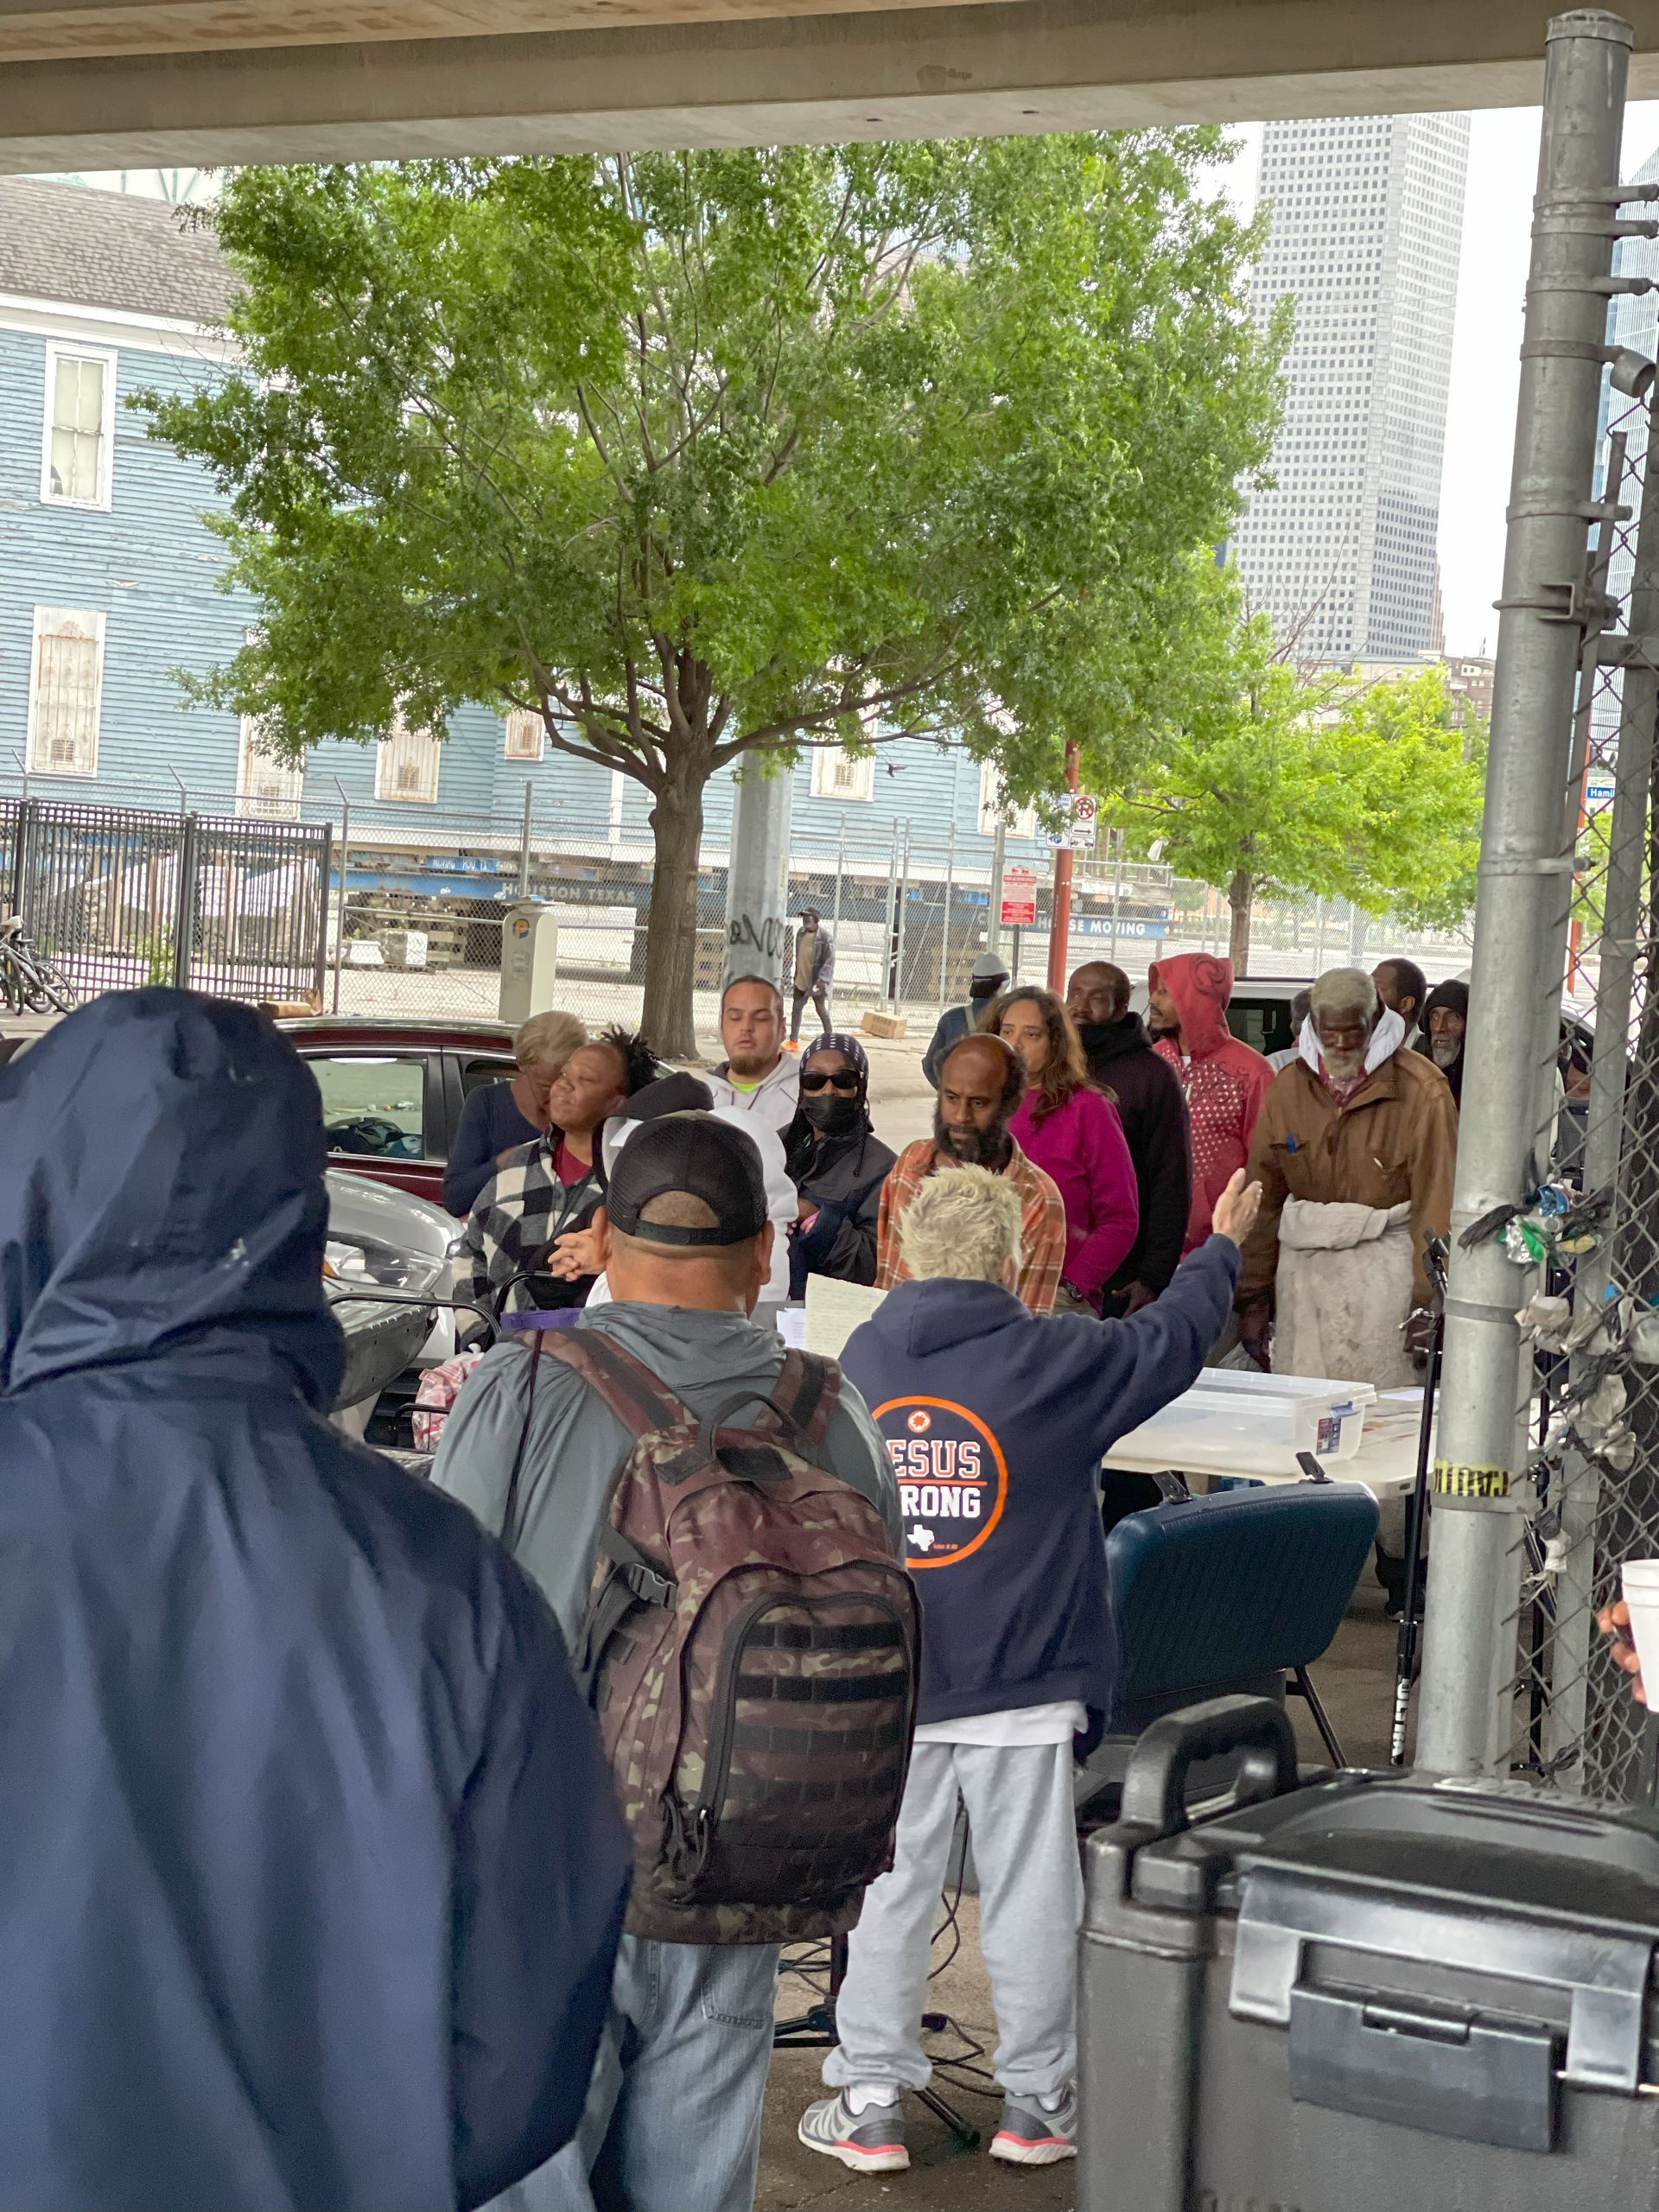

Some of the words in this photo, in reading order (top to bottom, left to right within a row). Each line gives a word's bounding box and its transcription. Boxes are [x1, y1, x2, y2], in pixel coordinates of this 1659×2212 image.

[588, 888, 636, 903] TEXAS
[1039, 917, 1084, 931] HSE
[887, 1440, 981, 1479] ESUS
[899, 1485, 981, 1518] RONG
